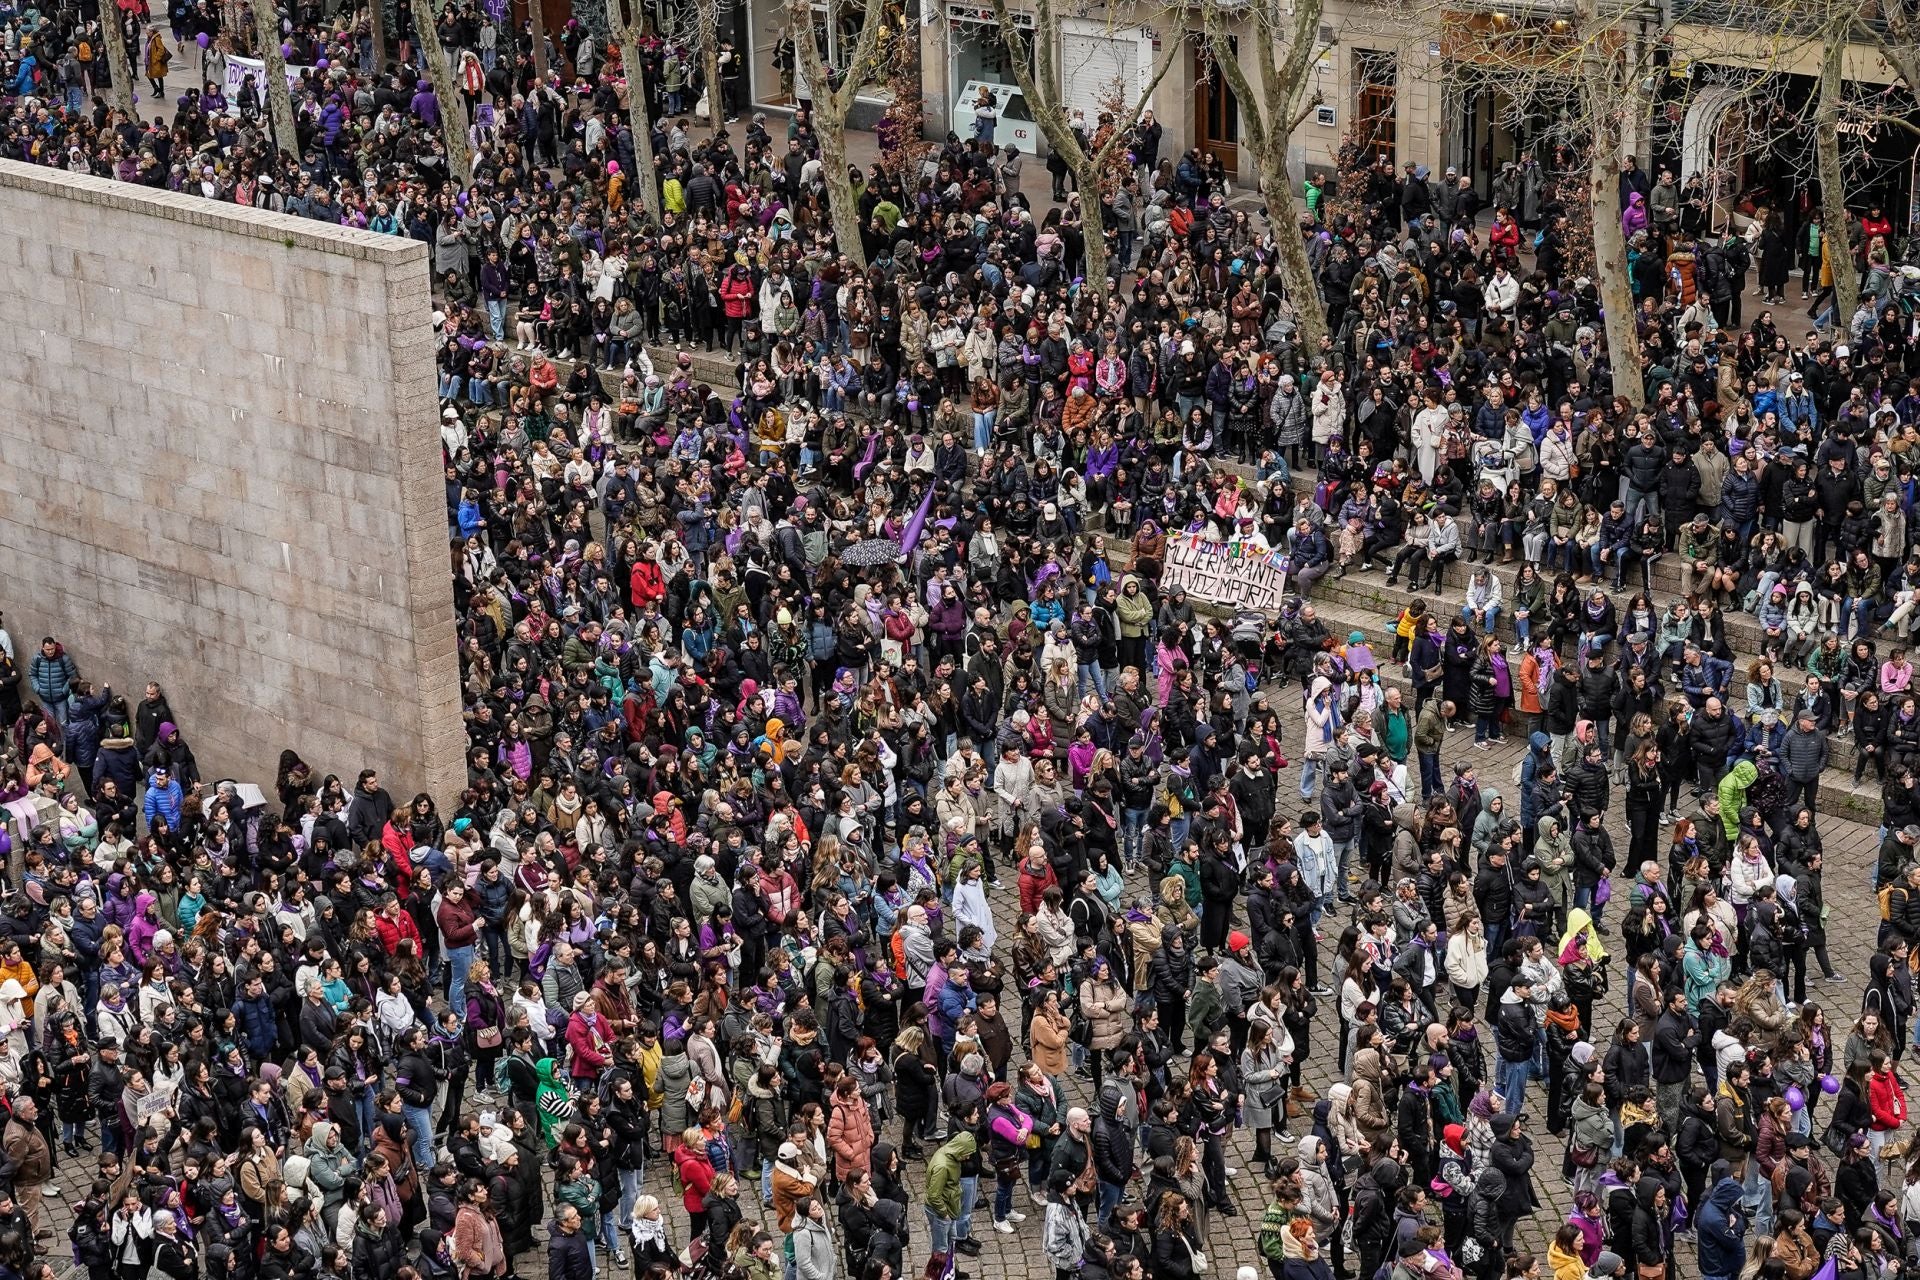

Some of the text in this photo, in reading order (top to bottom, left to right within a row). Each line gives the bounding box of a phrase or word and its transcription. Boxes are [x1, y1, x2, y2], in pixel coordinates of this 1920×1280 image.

[1836, 117, 1877, 143] iarritz
[1164, 543, 1219, 574] MUJER
[1163, 566, 1183, 586] TU
[1187, 570, 1218, 595] VOZ
